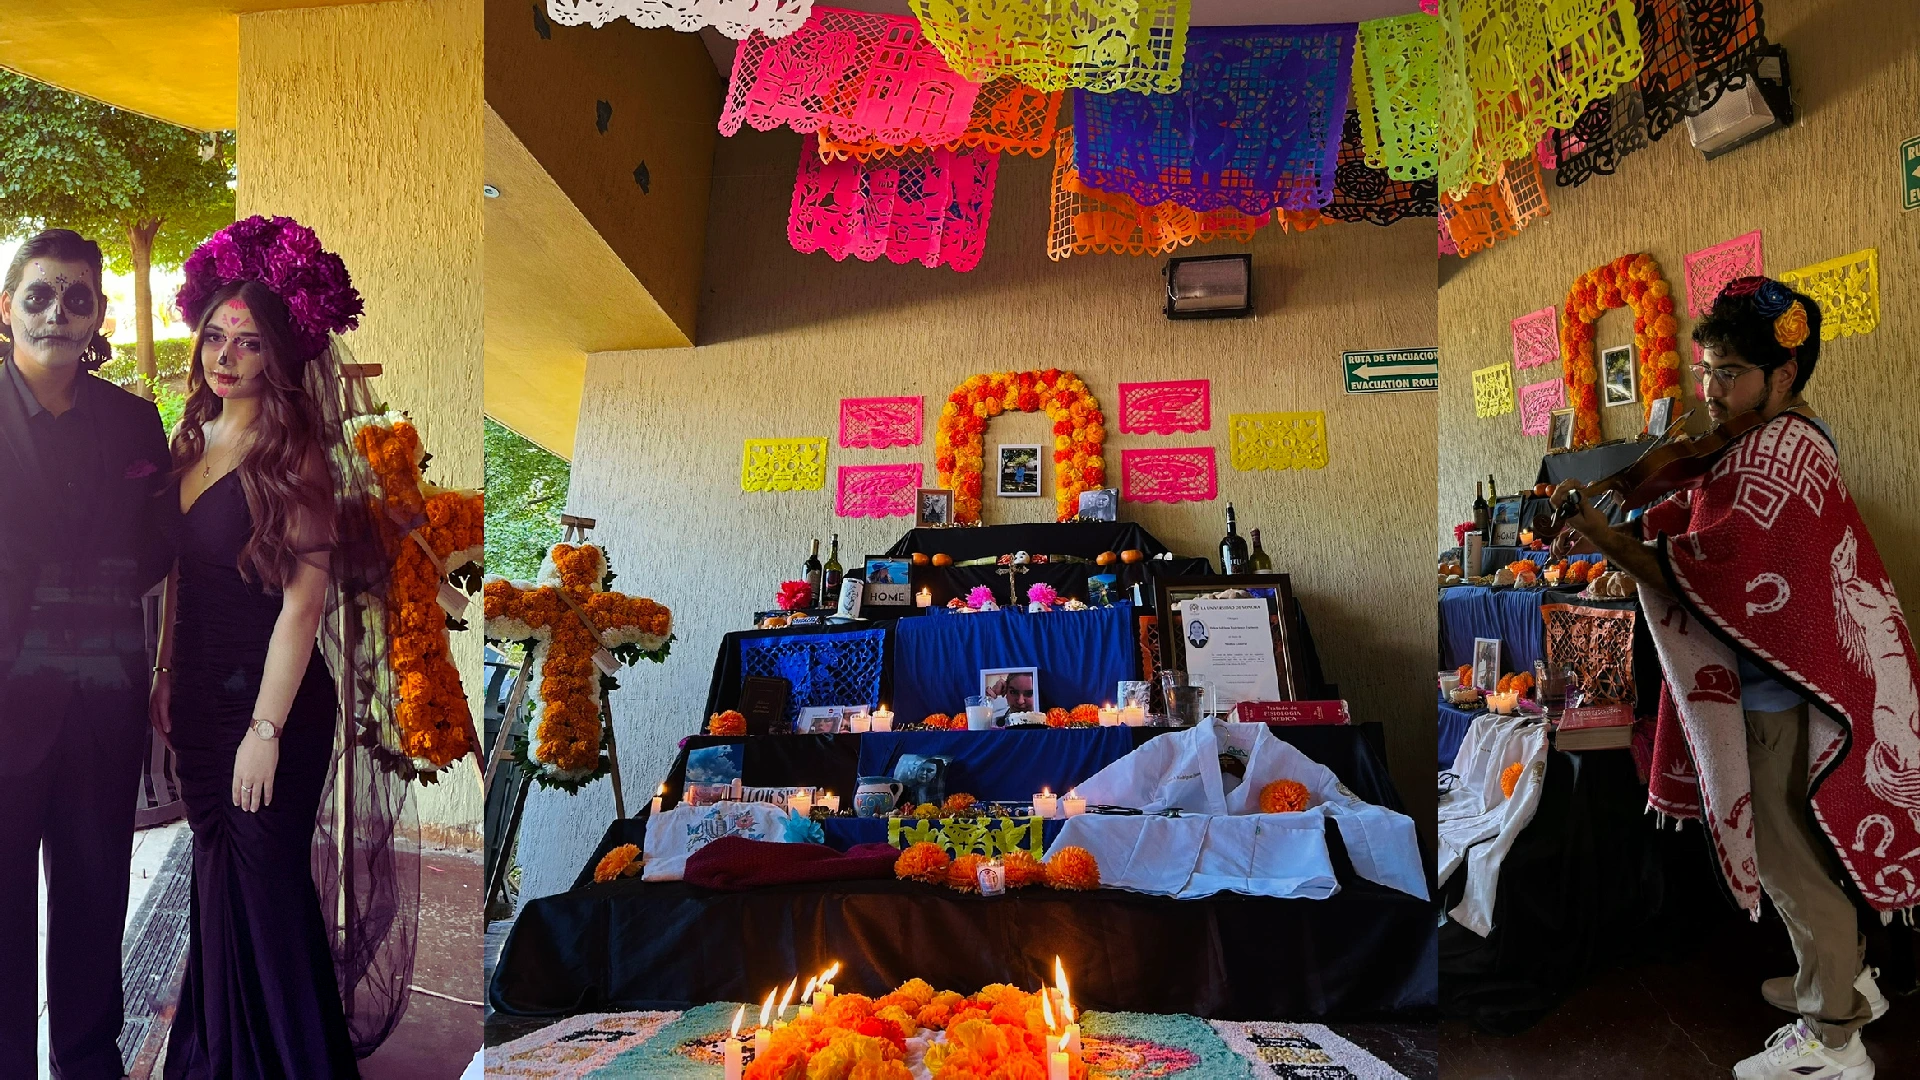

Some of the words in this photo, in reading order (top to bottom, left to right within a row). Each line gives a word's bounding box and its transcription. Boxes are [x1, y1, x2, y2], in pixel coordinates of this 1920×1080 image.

[1348, 355, 1371, 364] RUTA
[1373, 354, 1385, 363] DE
[1351, 379, 1410, 390] EVACUATION
[870, 592, 905, 602] HOME
